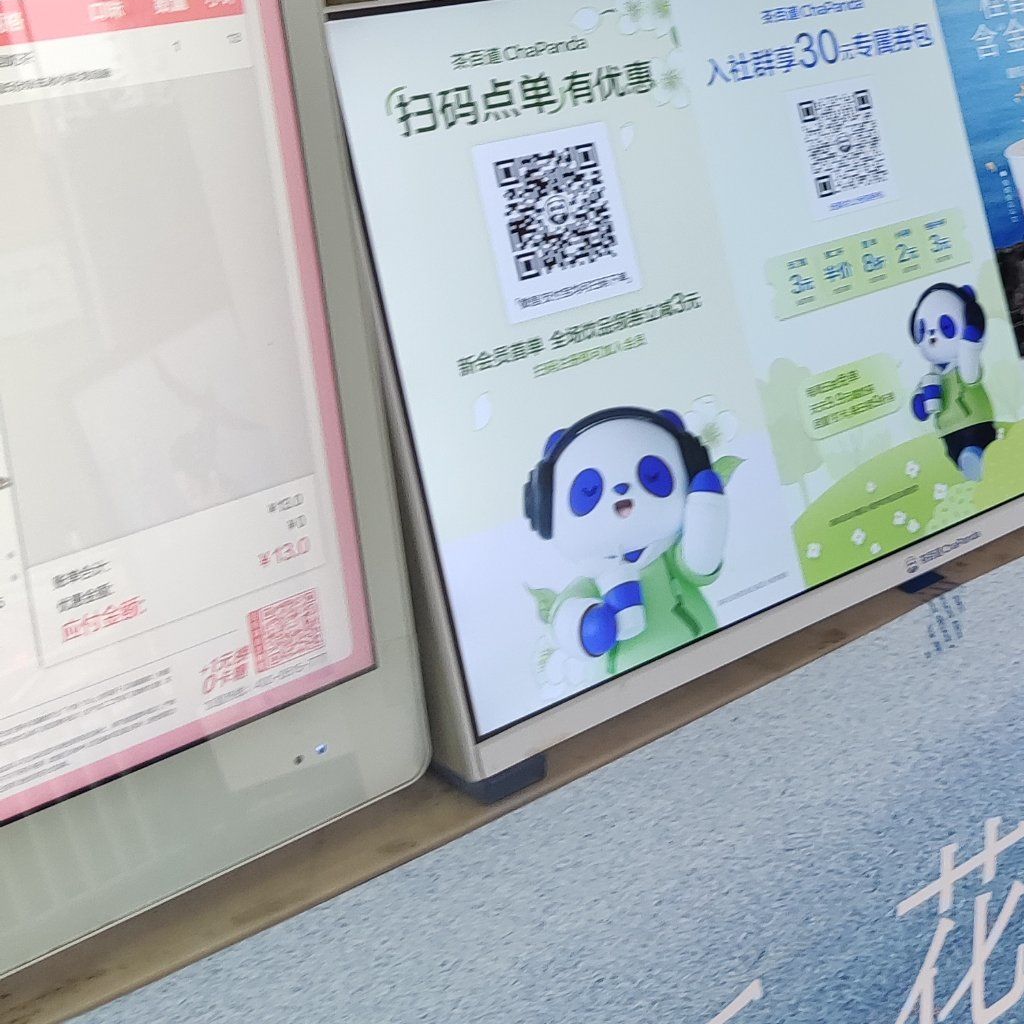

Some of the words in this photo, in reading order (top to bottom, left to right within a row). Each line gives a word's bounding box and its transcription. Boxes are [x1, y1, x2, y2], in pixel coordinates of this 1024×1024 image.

[451, 46, 504, 71] 茶百道
[503, 35, 590, 63] ChaPanda
